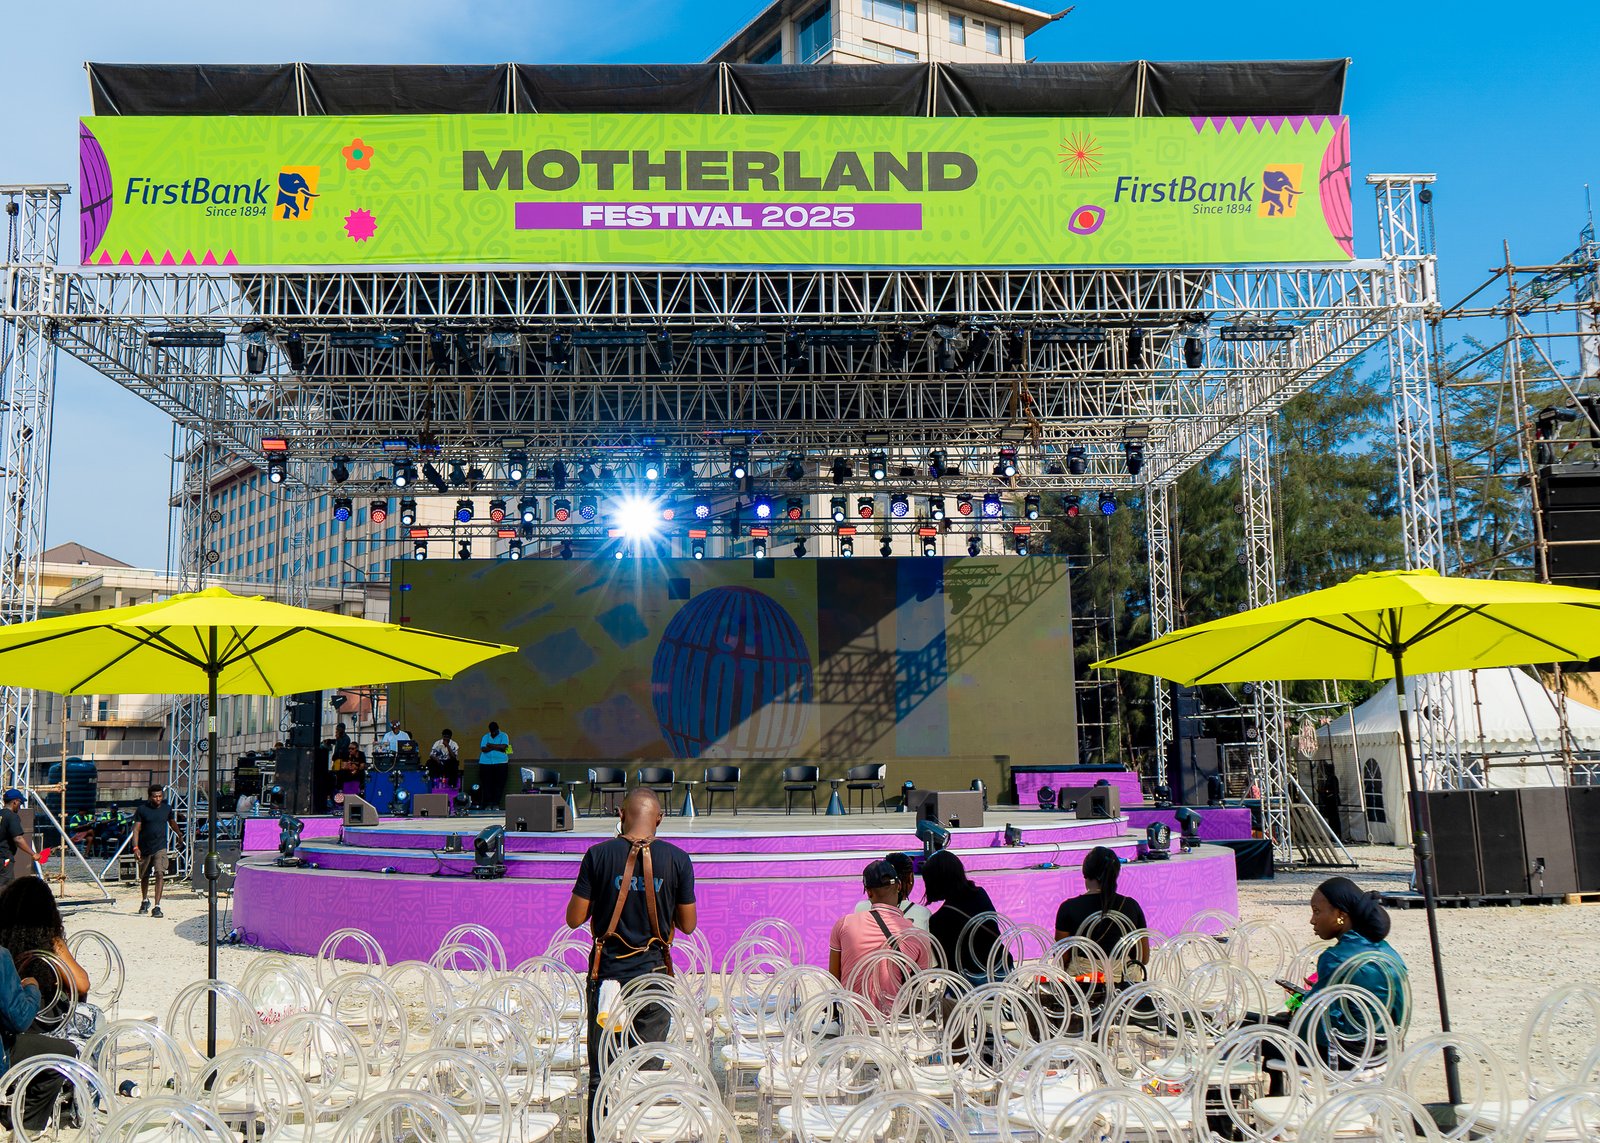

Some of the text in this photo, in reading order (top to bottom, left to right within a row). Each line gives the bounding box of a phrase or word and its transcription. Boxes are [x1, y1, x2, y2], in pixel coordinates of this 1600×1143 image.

[463, 149, 978, 192] MOTHERLAND
[124, 177, 271, 205] FirstBank
[1113, 175, 1255, 203] FirstBank
[205, 205, 267, 217] Since 1894
[582, 205, 856, 228] FESTIVAL 2025
[1192, 203, 1252, 215] Since 1894
